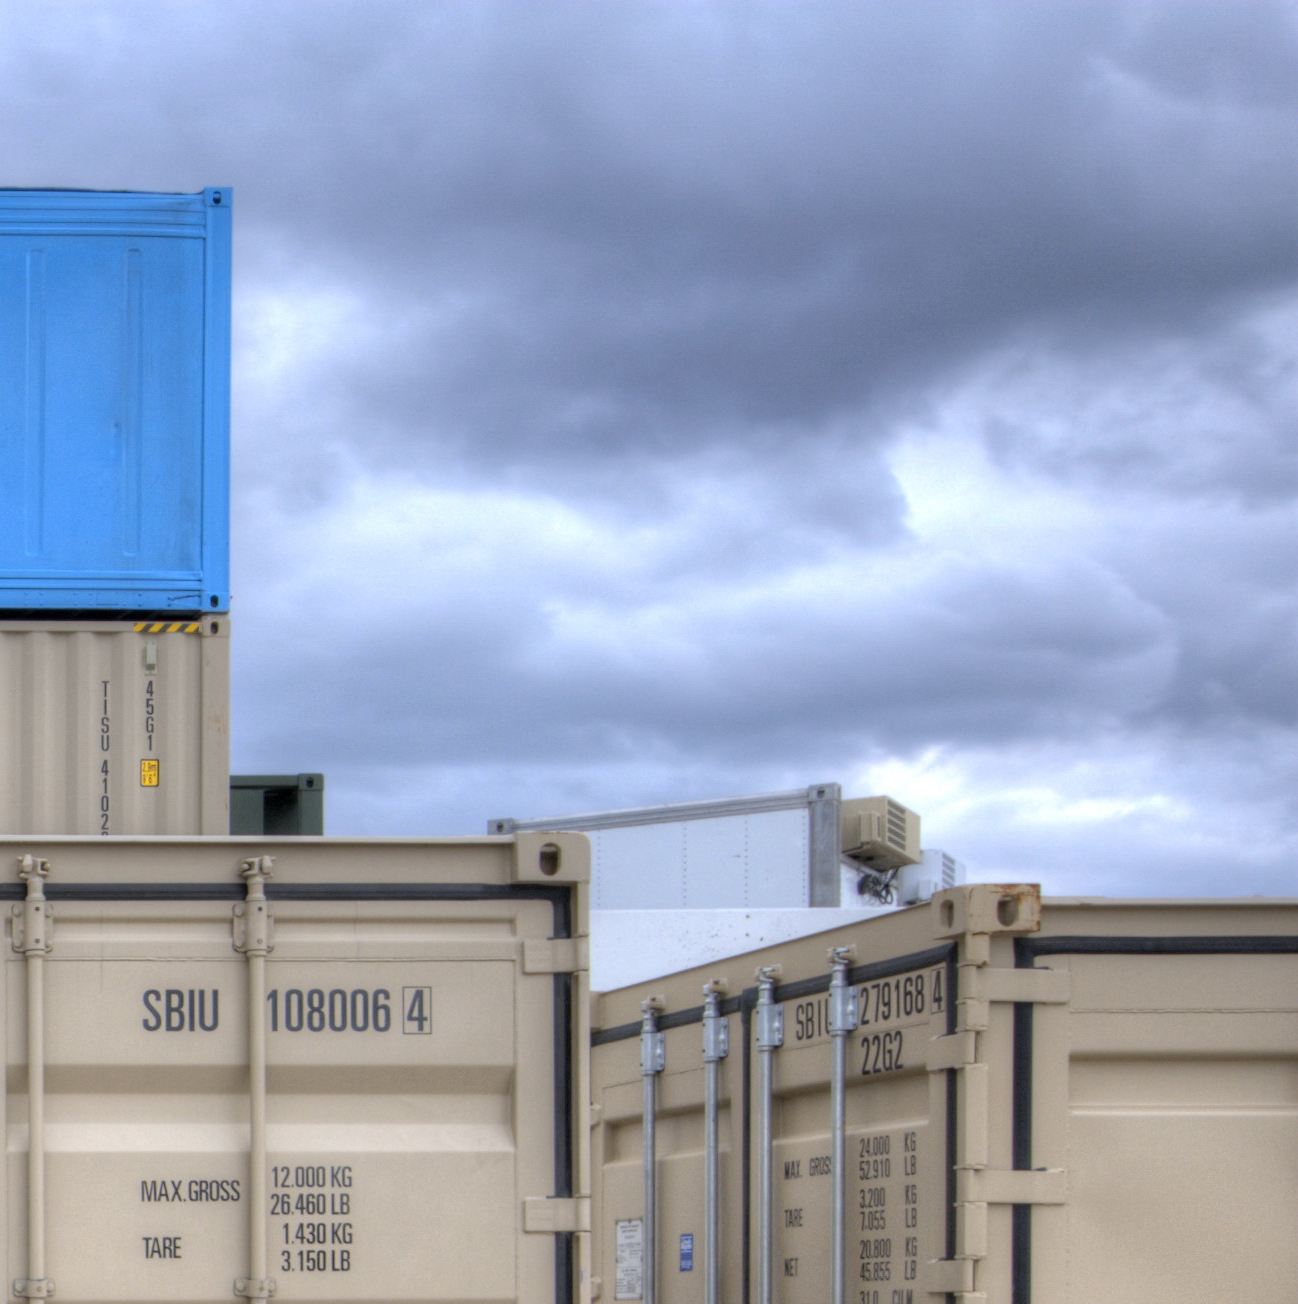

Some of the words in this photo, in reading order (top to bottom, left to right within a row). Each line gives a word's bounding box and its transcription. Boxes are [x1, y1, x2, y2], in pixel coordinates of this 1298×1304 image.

[101, 680, 110, 751] TISU
[146, 680, 154, 751] 45G1
[101, 759, 110, 835] 4102
[860, 974, 925, 1026] 279168
[933, 970, 943, 1011] 4
[142, 989, 219, 1032] SBIU
[266, 989, 391, 1032] 108006
[406, 989, 428, 1032] 4
[861, 1031, 903, 1076] 22G2
[905, 1132, 916, 1152] KG
[905, 1155, 916, 1176] LB
[271, 1166, 326, 1188] 12.000
[331, 1166, 352, 1188] KG
[270, 1193, 326, 1215] 26.460
[331, 1193, 350, 1215] LB
[905, 1207, 917, 1228] LB
[283, 1223, 326, 1245] 1.430
[331, 1223, 353, 1245] KG
[142, 1237, 182, 1259] TARE
[281, 1250, 326, 1272] 3.150
[331, 1250, 351, 1272] LB
[905, 1260, 916, 1280] LB
